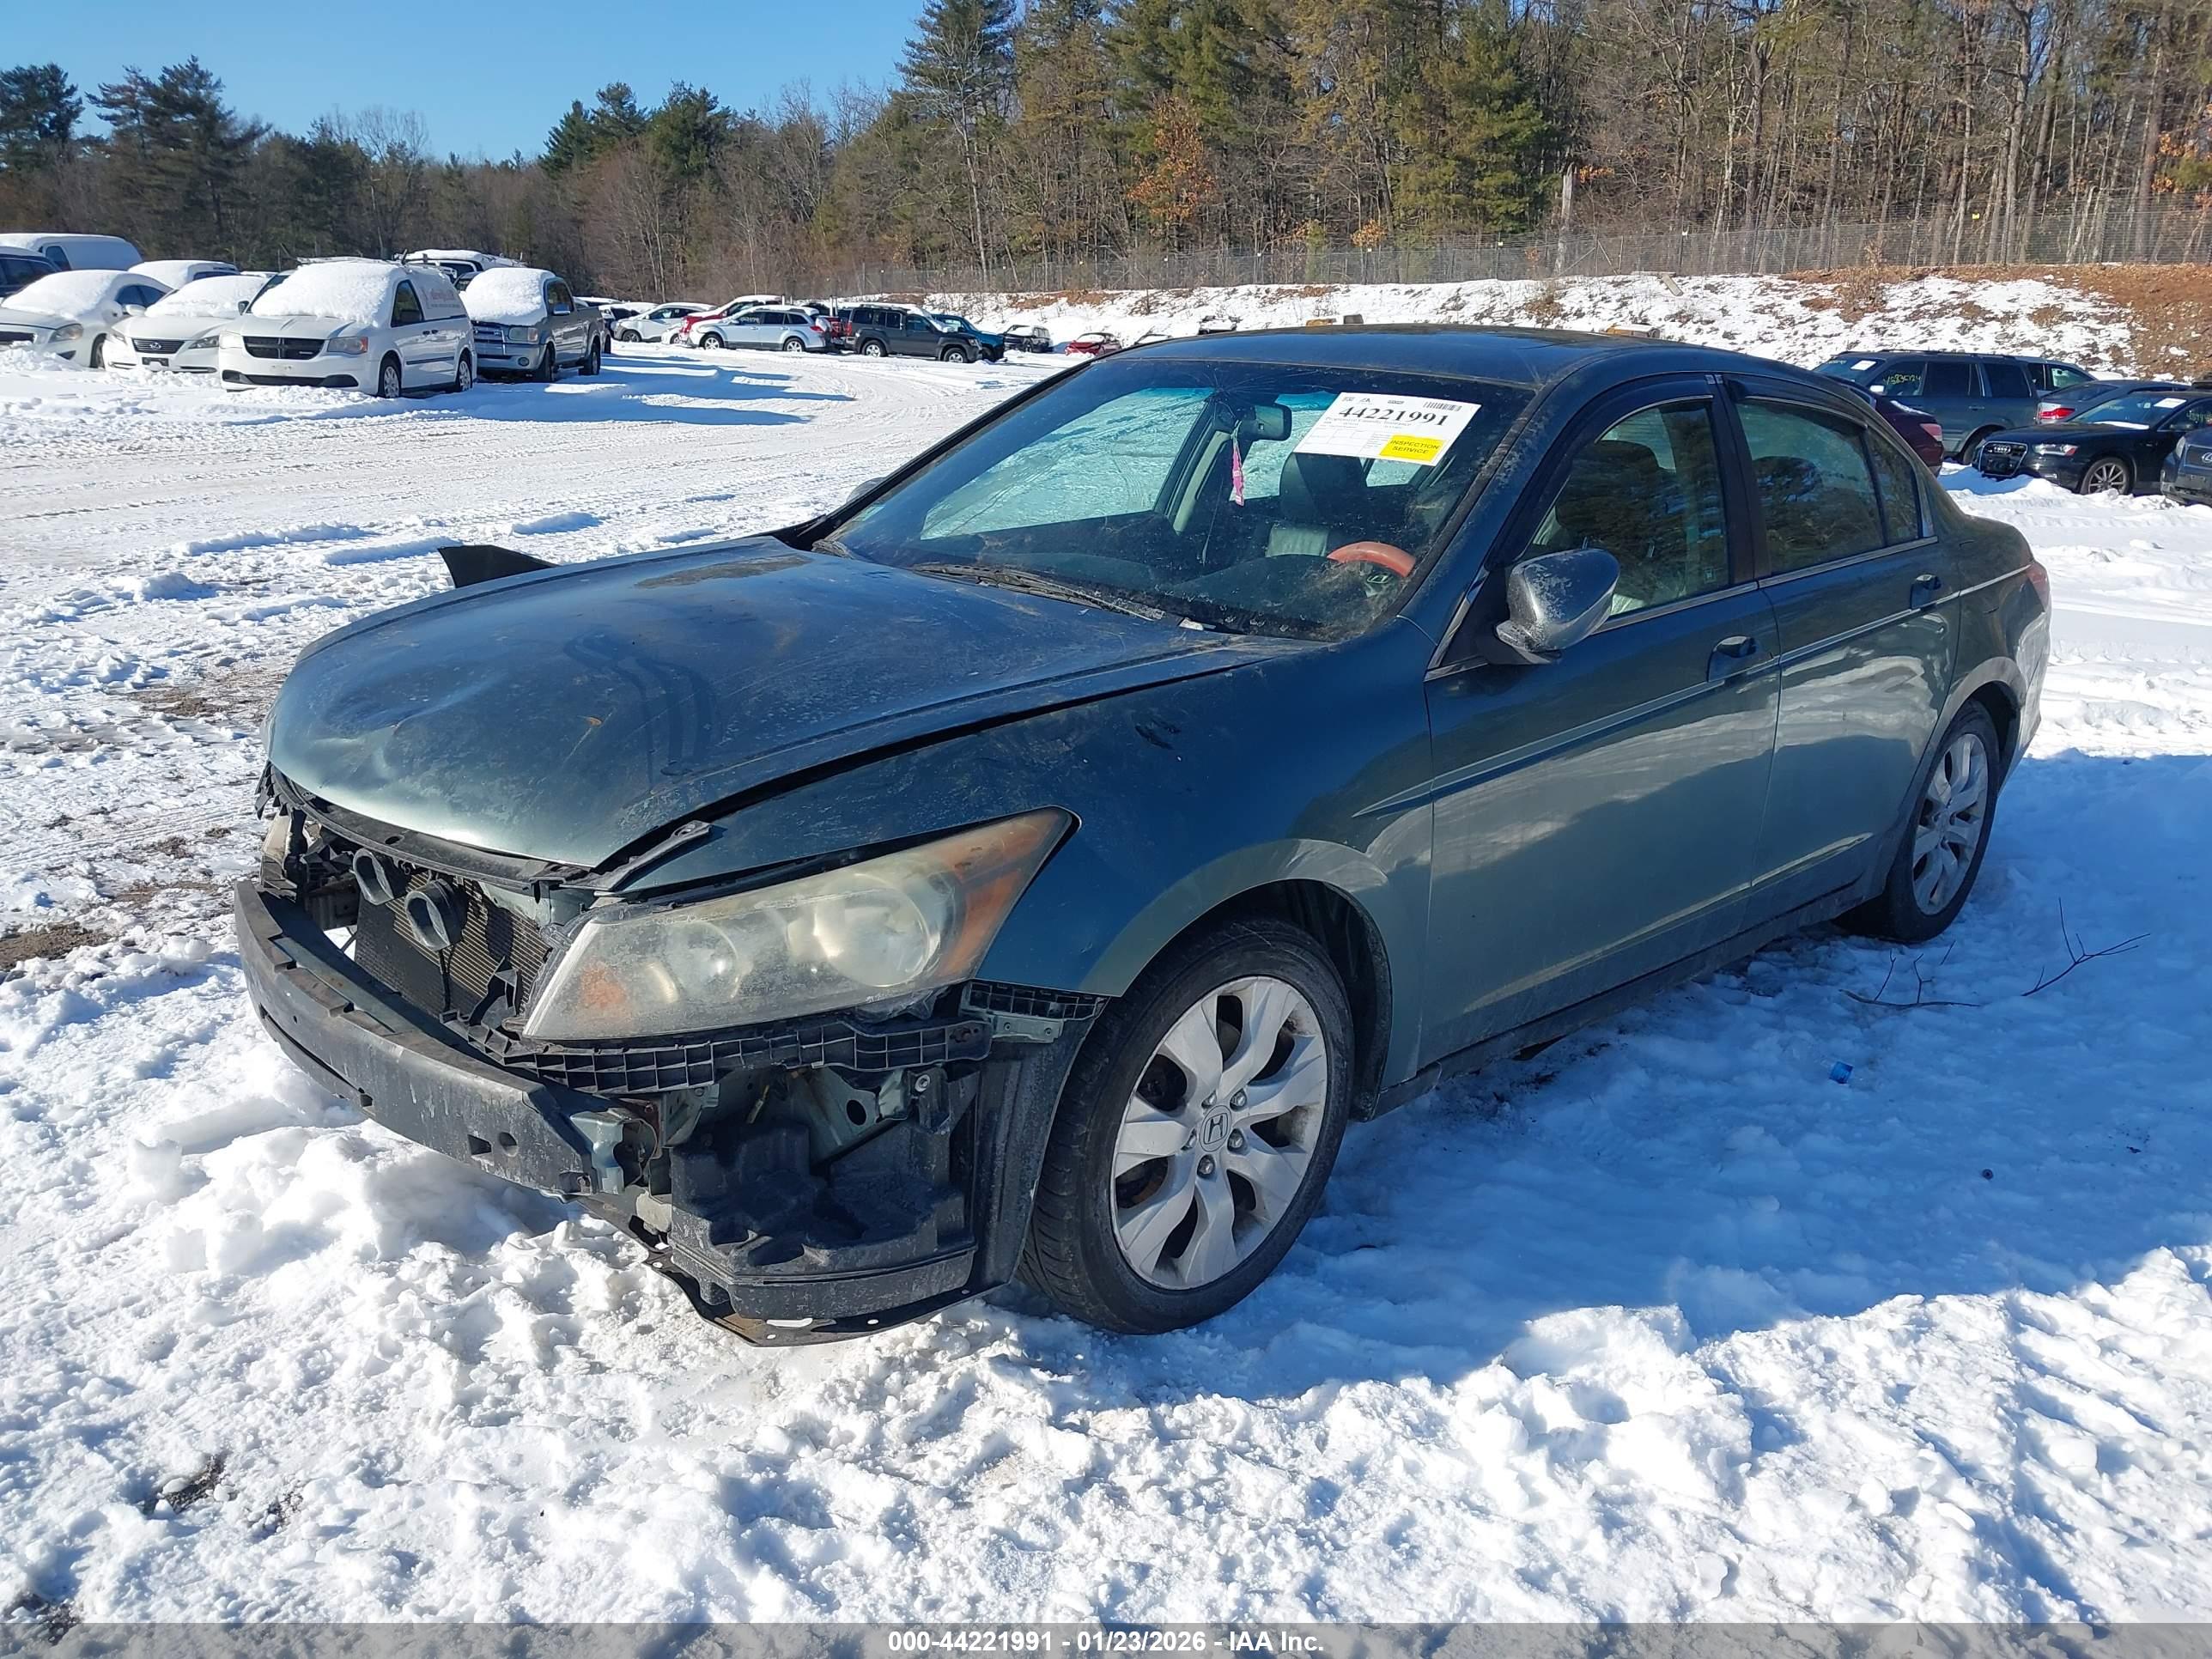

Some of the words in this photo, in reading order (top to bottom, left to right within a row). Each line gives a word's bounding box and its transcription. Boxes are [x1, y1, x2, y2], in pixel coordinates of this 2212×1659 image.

[1339, 406, 1449, 426] 44221991
[1390, 440, 1440, 450] INSPECTION
[1393, 446, 1430, 454] SERVICE
